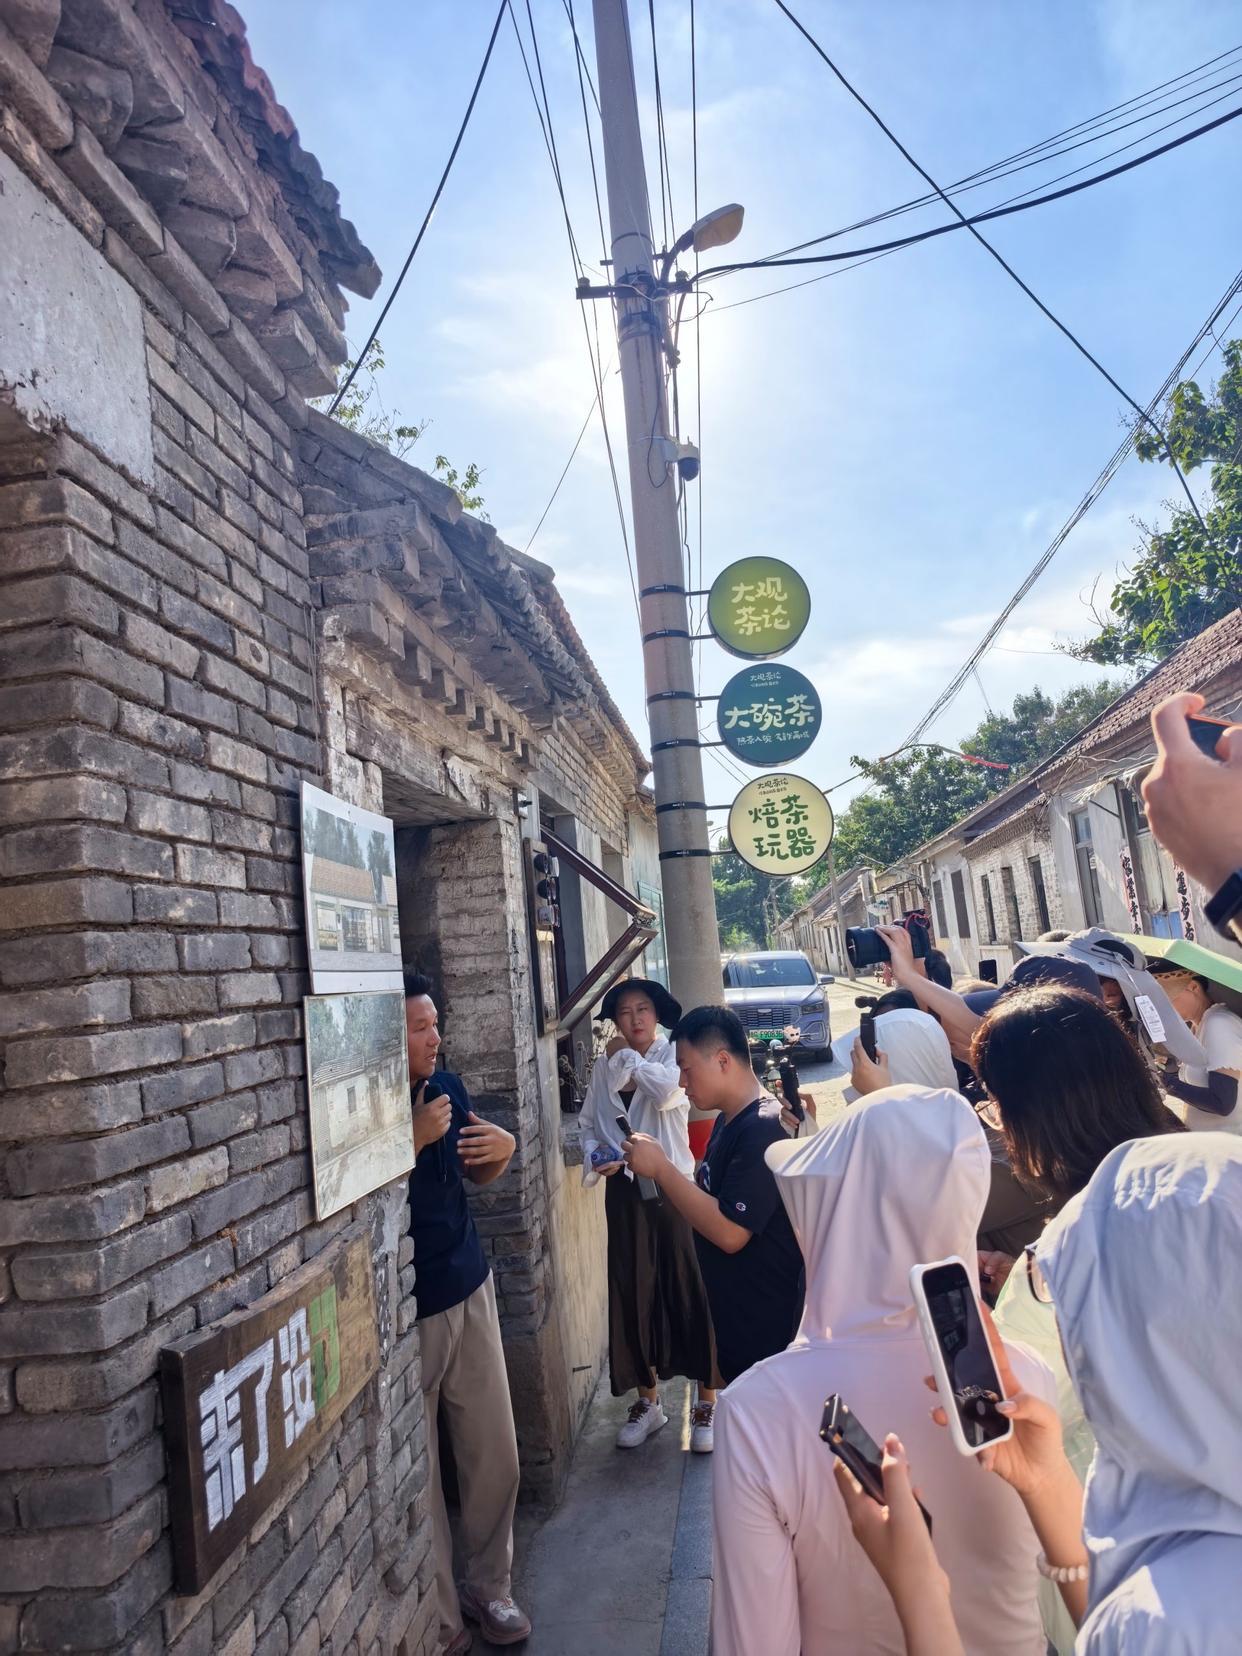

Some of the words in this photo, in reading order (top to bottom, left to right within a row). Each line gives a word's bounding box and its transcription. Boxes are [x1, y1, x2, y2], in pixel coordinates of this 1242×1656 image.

[731, 577, 788, 603] 大观
[734, 604, 791, 636] 茶论
[724, 694, 815, 731] 大碗茶
[748, 794, 809, 829] 焙茶
[752, 826, 817, 860] 玩器
